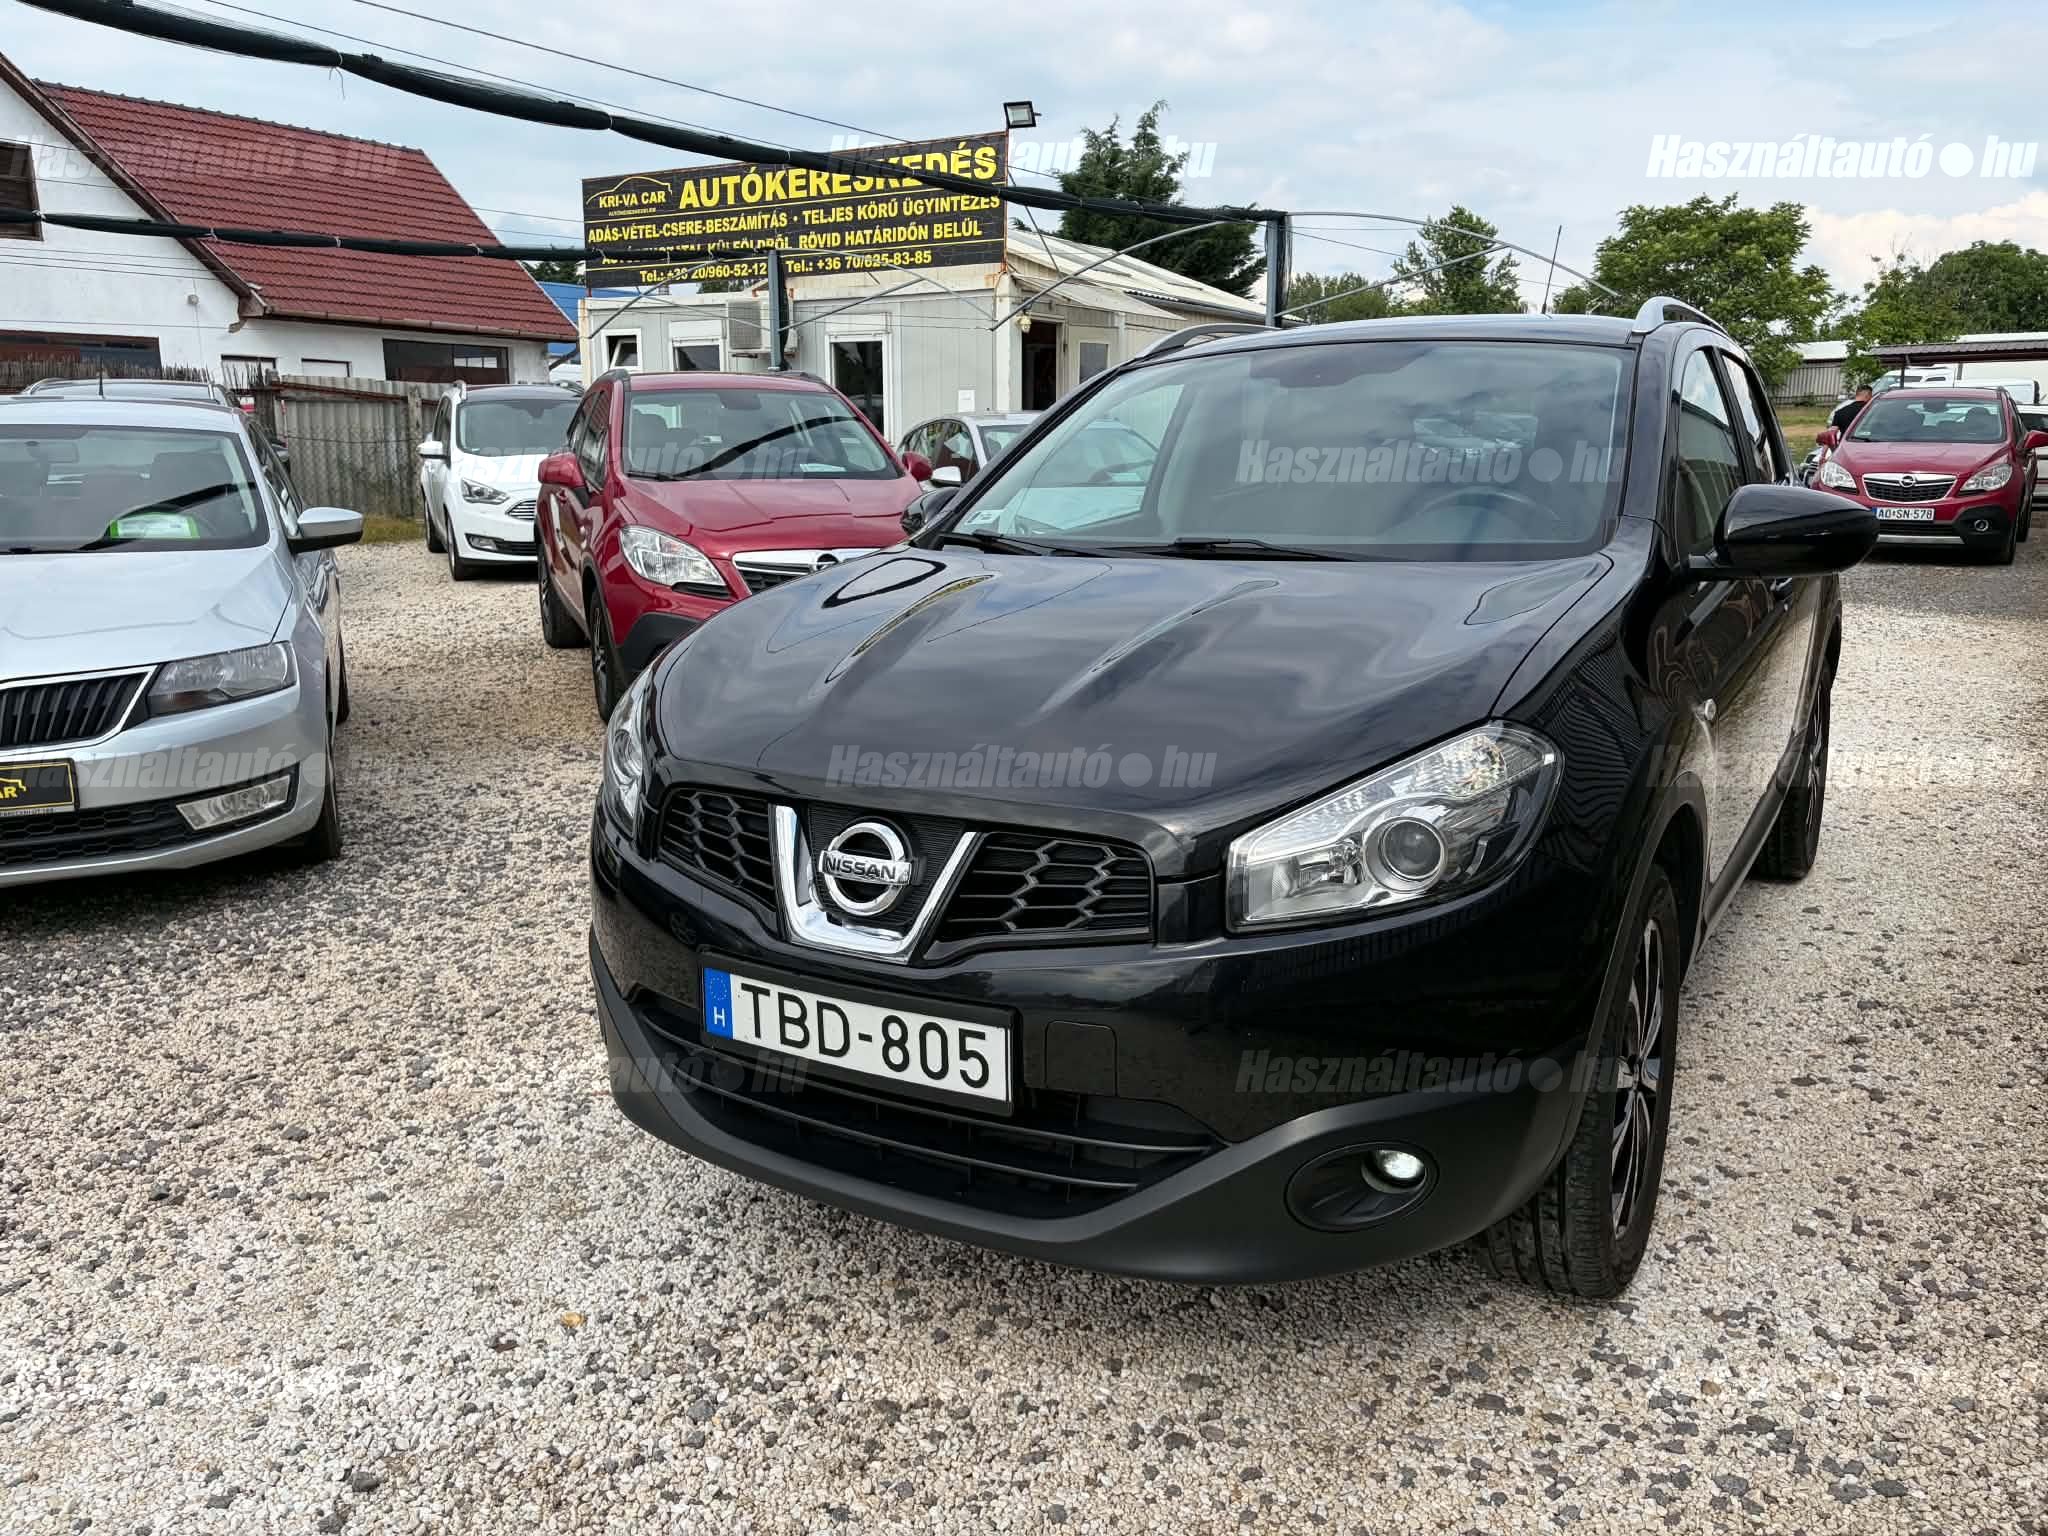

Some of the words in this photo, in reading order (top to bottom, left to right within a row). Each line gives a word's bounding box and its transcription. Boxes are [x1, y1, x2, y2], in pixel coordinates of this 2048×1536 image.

[599, 193, 638, 208] KRI-VA
[641, 191, 666, 204] CAR
[803, 206, 853, 224] TELJES
[799, 231, 840, 249] RÖVID
[845, 222, 928, 246] HATÁRIDŐN
[786, 260, 813, 272] Tel.:
[817, 257, 841, 270] +36
[823, 853, 896, 880] NISSAN
[713, 1006, 725, 1028] H
[741, 982, 989, 1089] TBD-805
